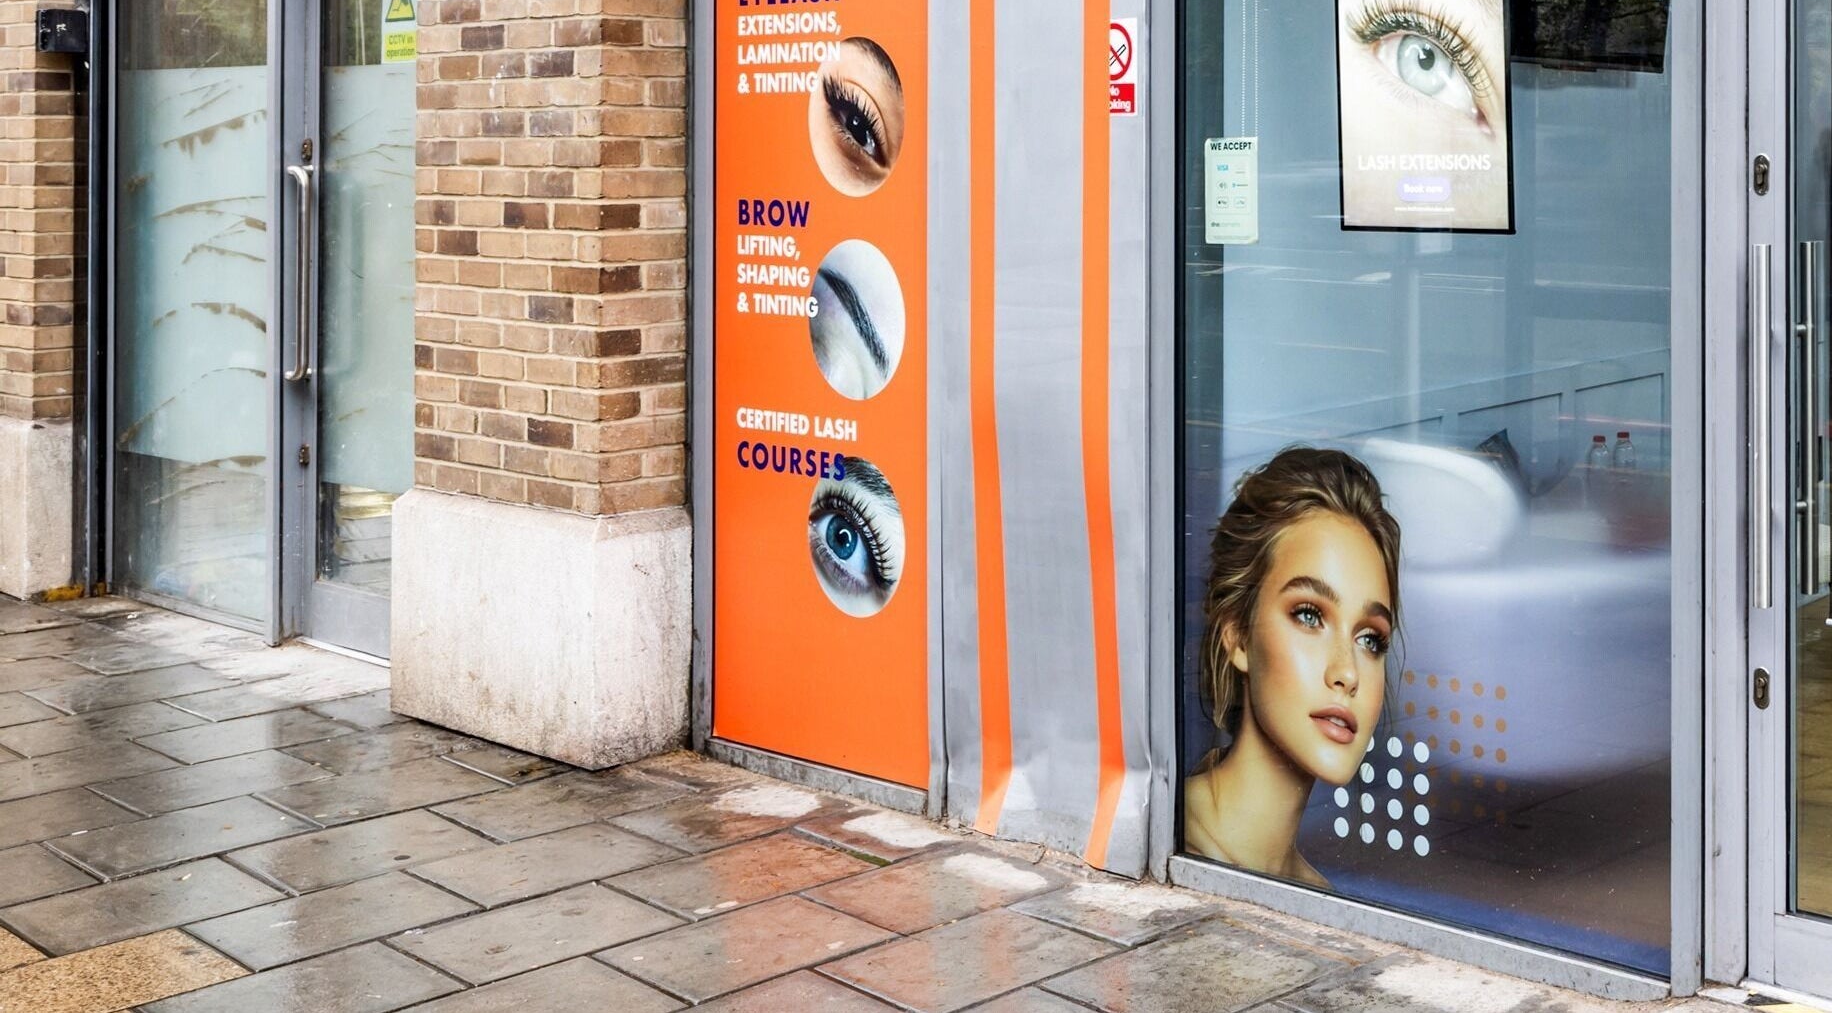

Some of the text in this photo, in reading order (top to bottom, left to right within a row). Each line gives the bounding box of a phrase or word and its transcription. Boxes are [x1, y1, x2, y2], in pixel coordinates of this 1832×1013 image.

[737, 11, 841, 36] EXTENSIONS,
[388, 34, 405, 45] CCTV
[386, 48, 415, 59] operation
[737, 41, 841, 65] LAMINATION
[737, 71, 819, 94] & TINTING
[1210, 142, 1252, 151] WE ACCEPT
[1358, 153, 1492, 171] LASH EXTENSIONS
[738, 199, 810, 227] BROW
[737, 235, 801, 261] LIFTING,
[737, 263, 810, 287] SHAPING
[737, 292, 819, 318] & TINTING
[736, 407, 858, 442] CERTIFIED LASH
[737, 441, 846, 481] COURSES
